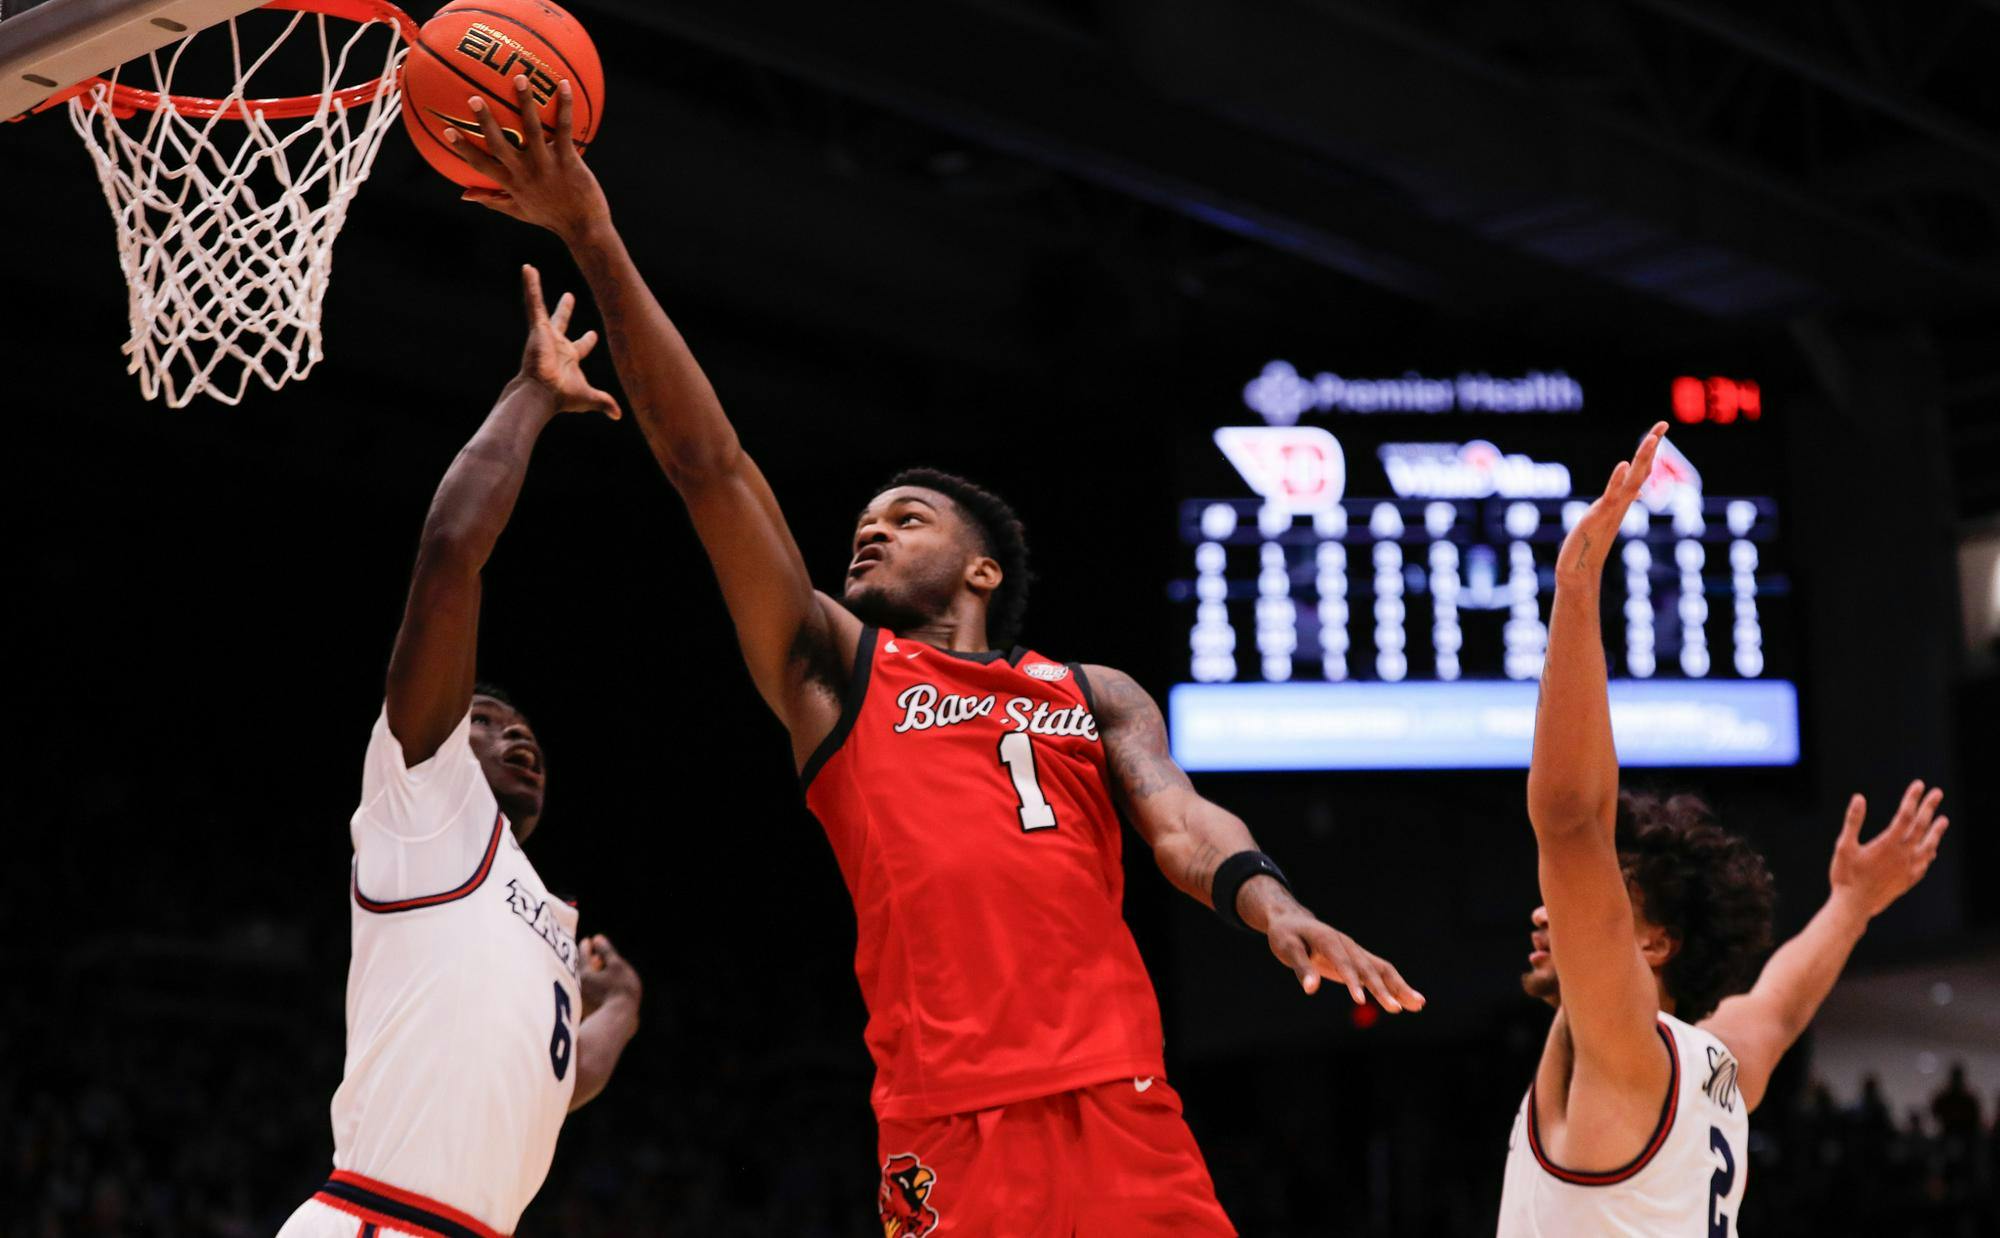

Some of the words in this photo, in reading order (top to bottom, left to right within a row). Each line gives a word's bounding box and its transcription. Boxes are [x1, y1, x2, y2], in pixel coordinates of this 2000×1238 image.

[456, 27, 558, 107] ELITE
[999, 697, 1099, 742] State
[997, 730, 1058, 834] 1
[549, 980, 571, 1082] 6
[1708, 1125, 1735, 1238] 2
